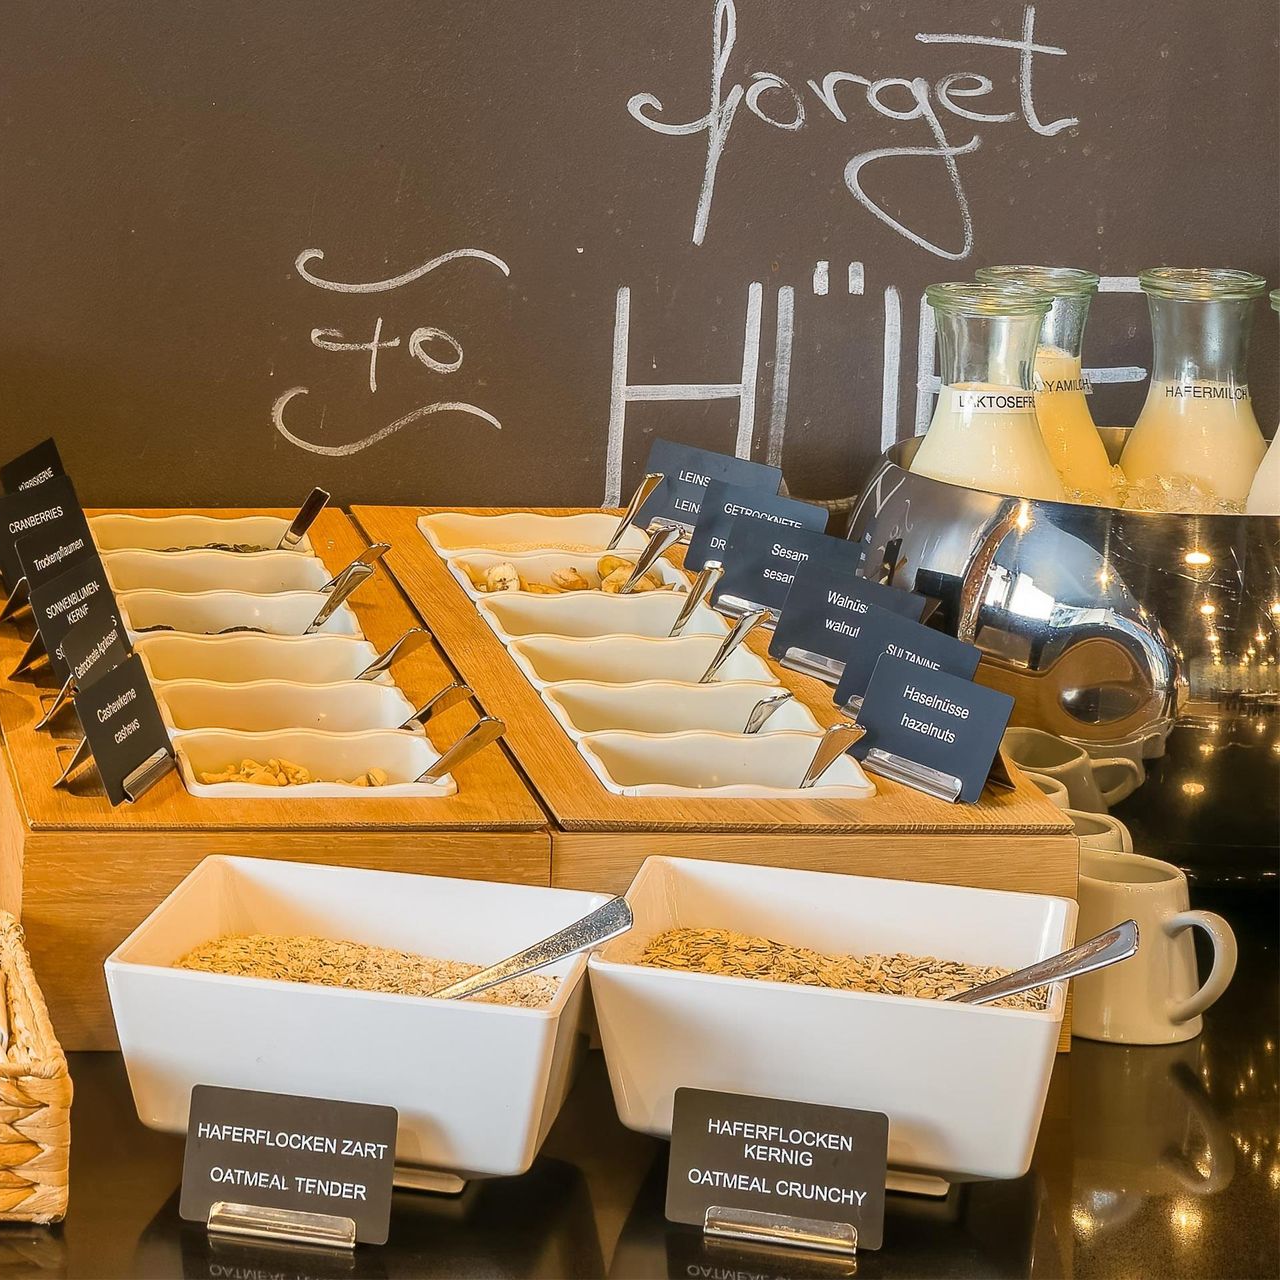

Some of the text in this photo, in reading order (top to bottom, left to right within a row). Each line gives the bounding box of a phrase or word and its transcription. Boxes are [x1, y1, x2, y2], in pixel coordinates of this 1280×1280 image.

[309, 316, 465, 393] to
[1034, 377, 1091, 393] YAMILCH
[1165, 384, 1248, 400] HAFERMILCH
[8, 506, 64, 534] CRANBERRIES
[674, 498, 702, 515] LEIN
[33, 538, 85, 572] Trockenpflaumen
[771, 543, 809, 562] Sesam
[45, 580, 101, 620] SONNENBLUMEN-
[96, 687, 138, 723] Cashewkerne
[903, 684, 970, 720] Haselnüsse
[114, 718, 141, 744] cashews
[900, 712, 956, 744] hazelnuts
[197, 1122, 389, 1160] HAFERFLOCKEN ZART
[708, 1118, 853, 1152] HAFERFLOCKEN
[744, 1143, 814, 1167] KERNIG
[209, 1166, 368, 1201] OATMEAL TENDER
[687, 1168, 868, 1206] OATMEAL CRUNCHY
